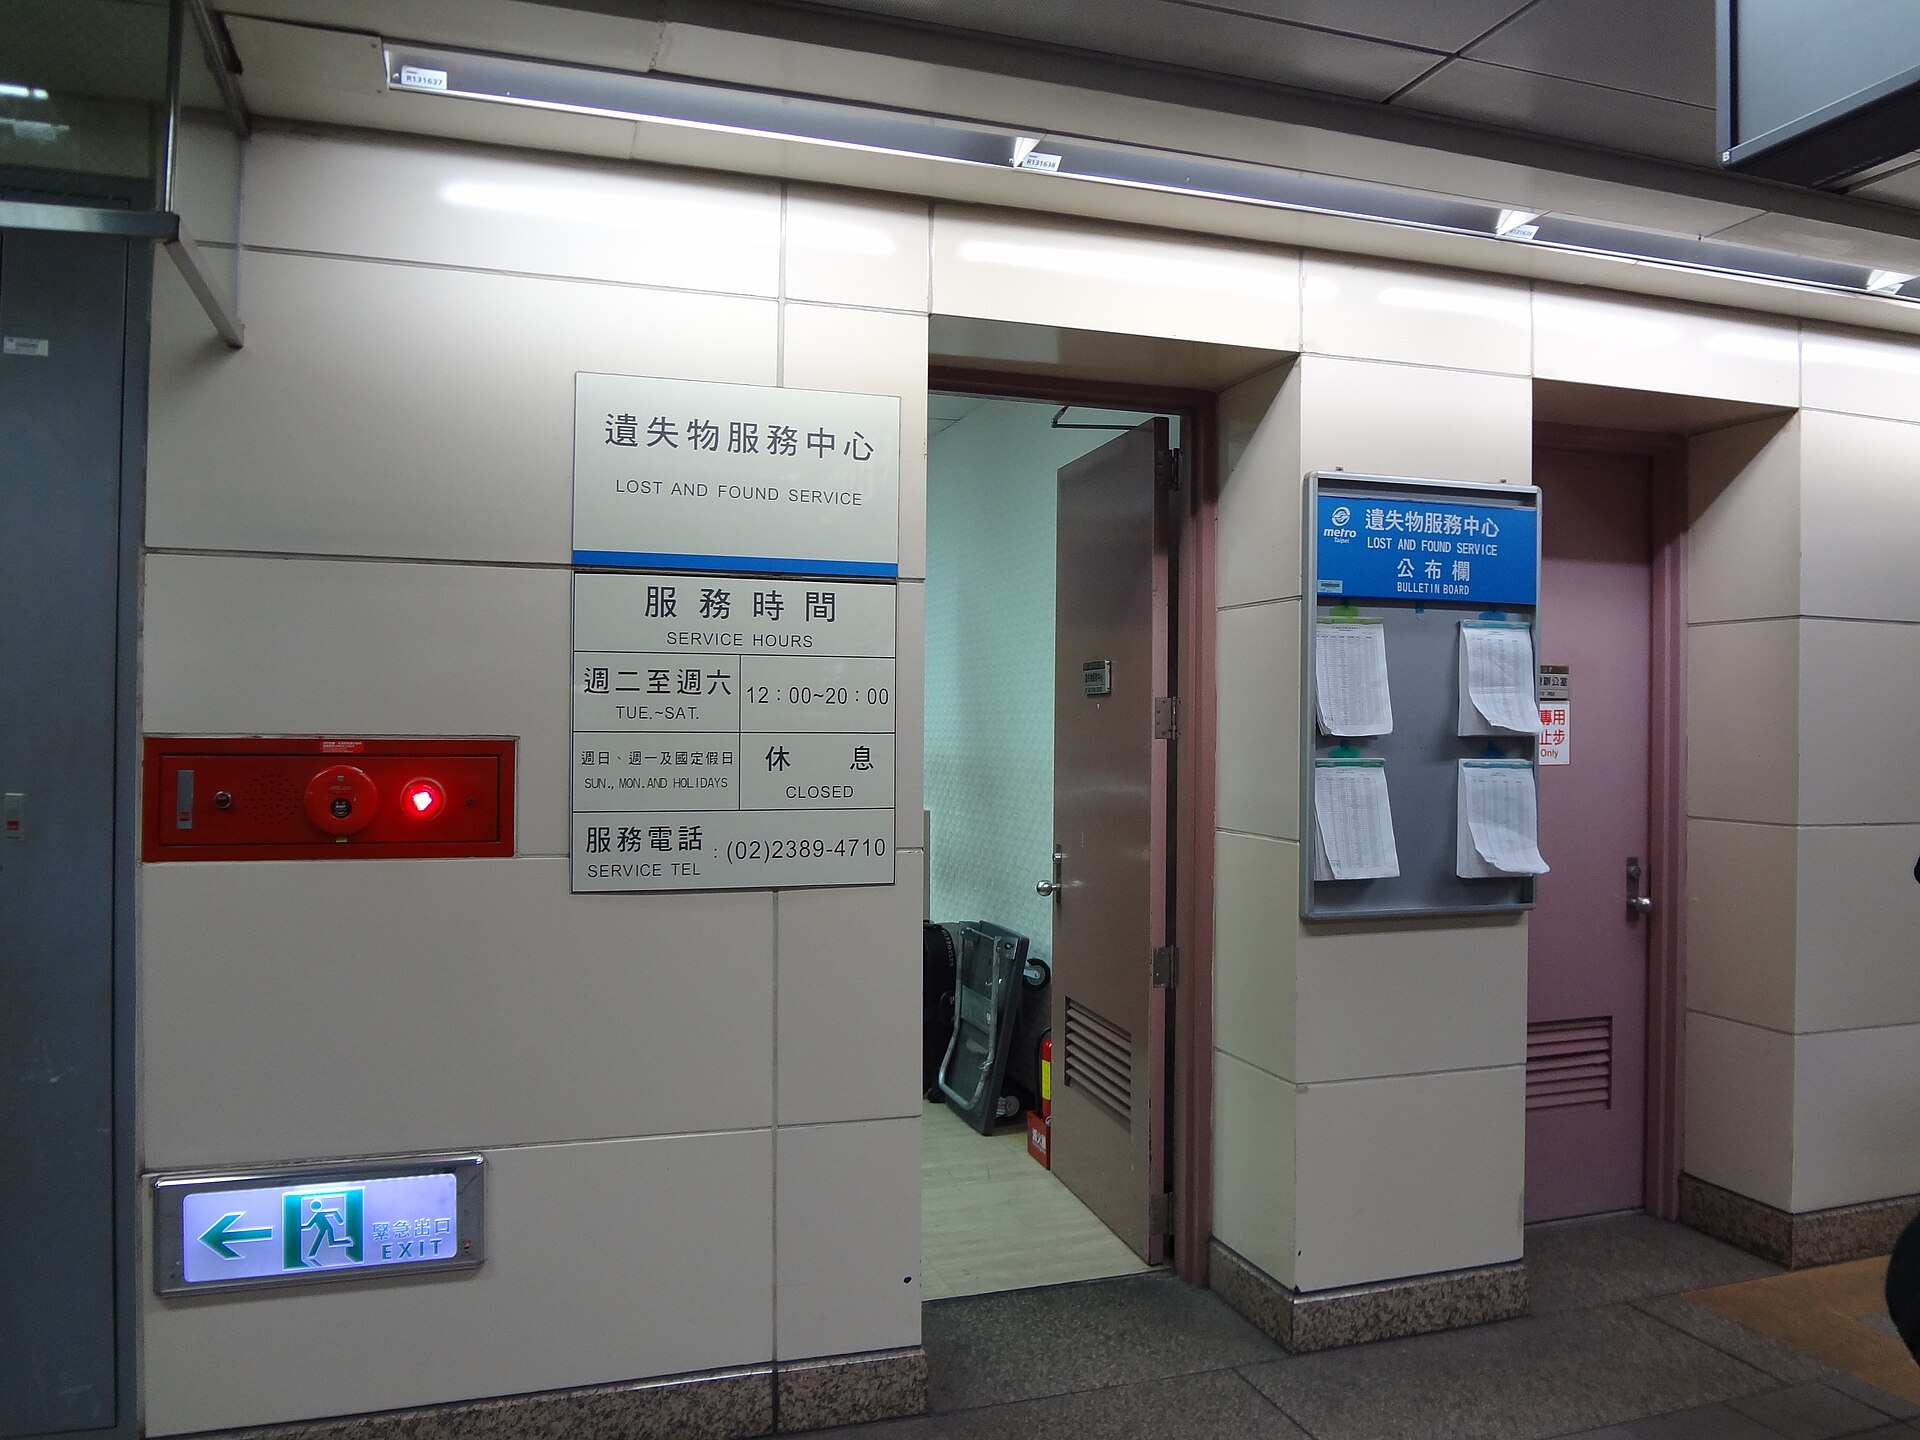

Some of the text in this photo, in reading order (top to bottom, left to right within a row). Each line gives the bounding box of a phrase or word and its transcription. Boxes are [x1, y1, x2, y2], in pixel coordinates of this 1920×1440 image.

[604, 413, 875, 461] 遺失物服務中心
[616, 479, 862, 506] LOST AND FOUND SERVICE
[1323, 528, 1357, 538] metro
[1364, 508, 1500, 538] 遺失物服務中心
[1367, 536, 1498, 556] LOST AND FOUND SERVICE
[1396, 558, 1470, 582] 公布欄
[1397, 581, 1470, 596] BULLETIN BOARD
[644, 585, 836, 623] 服務時間
[666, 631, 813, 648] SERVICE HOURS
[583, 667, 732, 696] 週二至週六
[581, 750, 733, 766] 週日、週一及國定假日
[1540, 748, 1559, 759] Only
[673, 777, 728, 789] HOLIDAYS
[785, 785, 854, 799] CLOSED
[585, 825, 703, 854] 服務電話
[727, 838, 886, 865] (02)2389-4710
[587, 862, 701, 878] SERVICE TEL
[372, 1218, 450, 1240] 緊急出口
[381, 1239, 442, 1260] EXIT
